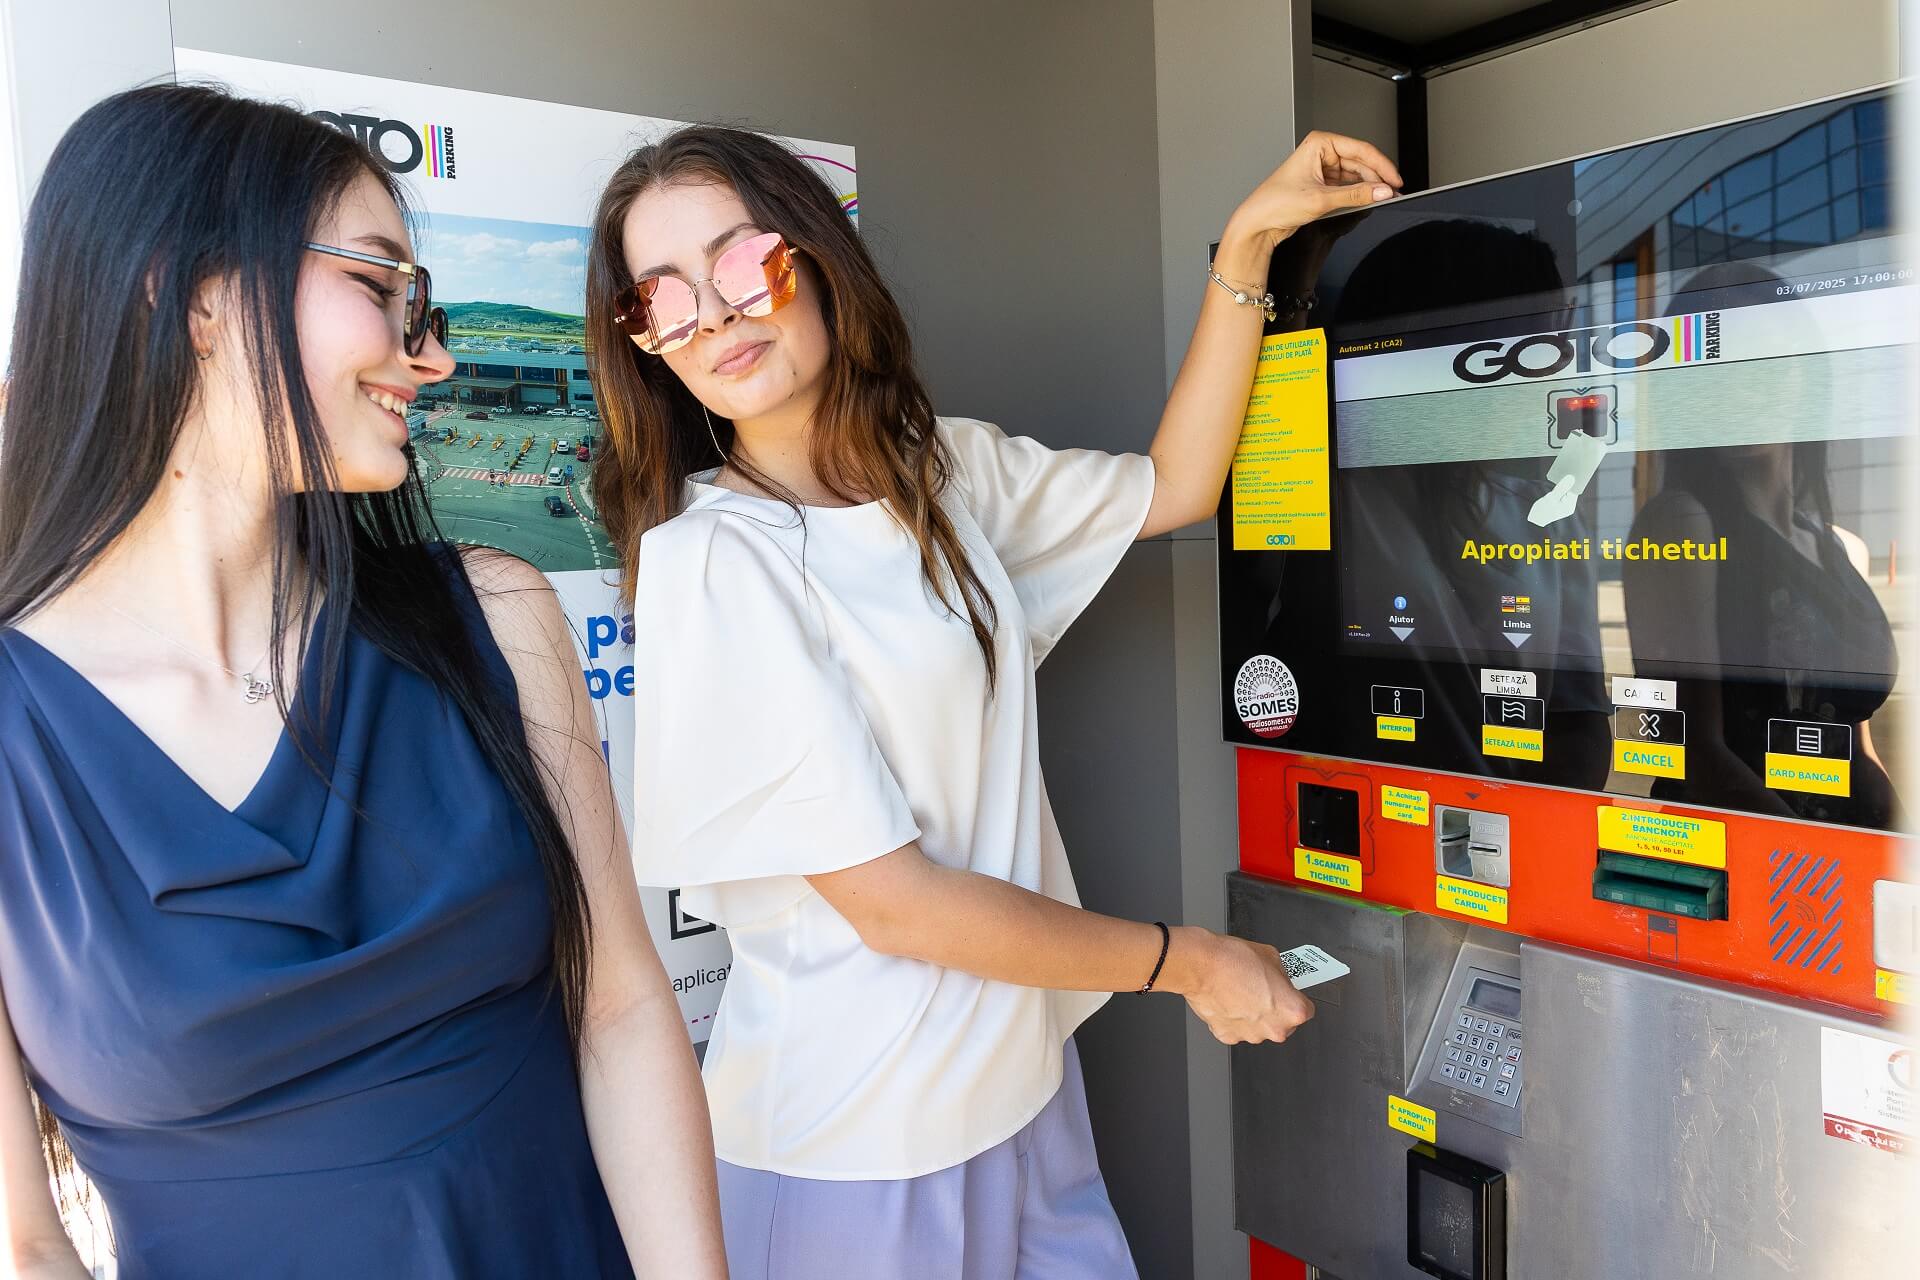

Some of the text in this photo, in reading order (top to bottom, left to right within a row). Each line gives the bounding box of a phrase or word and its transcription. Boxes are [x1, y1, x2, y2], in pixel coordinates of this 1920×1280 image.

[444, 126, 456, 179] PARKING
[1776, 278, 1846, 295] 03/07/2025
[1706, 312, 1720, 360] PARKING
[1339, 343, 1372, 353] Automat
[1381, 339, 1403, 349] (CA2)
[1453, 322, 1670, 383] GOTO
[1461, 536, 1728, 565] Apropiati tichetul
[1389, 615, 1415, 624] Ajutor
[1503, 620, 1532, 629] Limba
[1256, 692, 1275, 700] radio
[1496, 685, 1522, 695] LIMBA
[1624, 688, 1666, 701] CAEL
[1248, 717, 1292, 729] radiosomes.ro
[1517, 741, 1541, 751] LIMBA
[1623, 751, 1675, 768] CANCEL
[1769, 767, 1840, 783] CARD BANCAR
[1632, 824, 1688, 839] BANCNOTA
[1309, 870, 1351, 887] TICHETUL
[1454, 898, 1489, 912] CARDUL
[1398, 1116, 1426, 1131] CARDUL
